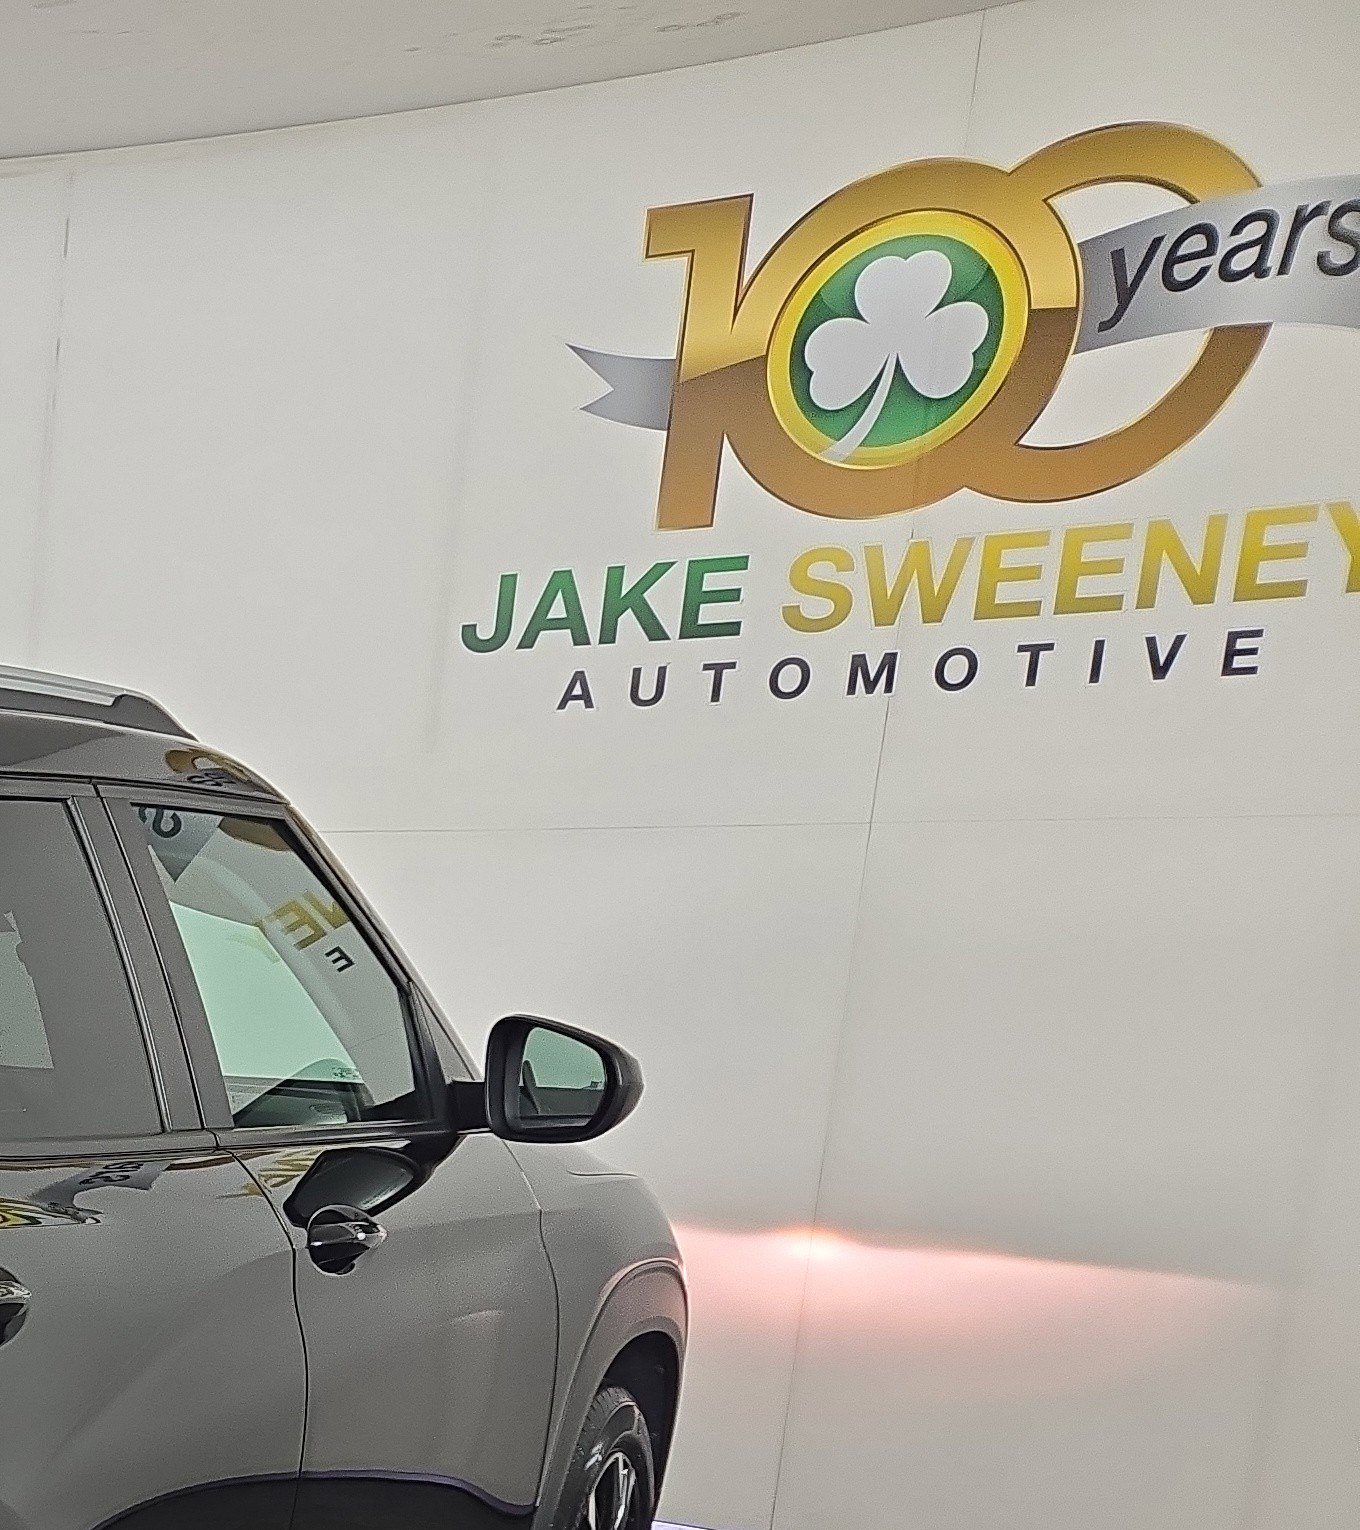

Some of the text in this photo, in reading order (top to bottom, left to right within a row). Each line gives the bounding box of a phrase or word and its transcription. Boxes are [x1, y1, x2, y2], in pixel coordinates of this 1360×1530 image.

[1098, 197, 1360, 333] years
[644, 119, 1267, 531] 100
[461, 554, 750, 654] JAKE
[556, 628, 1265, 711] AUTOMOTIVE
